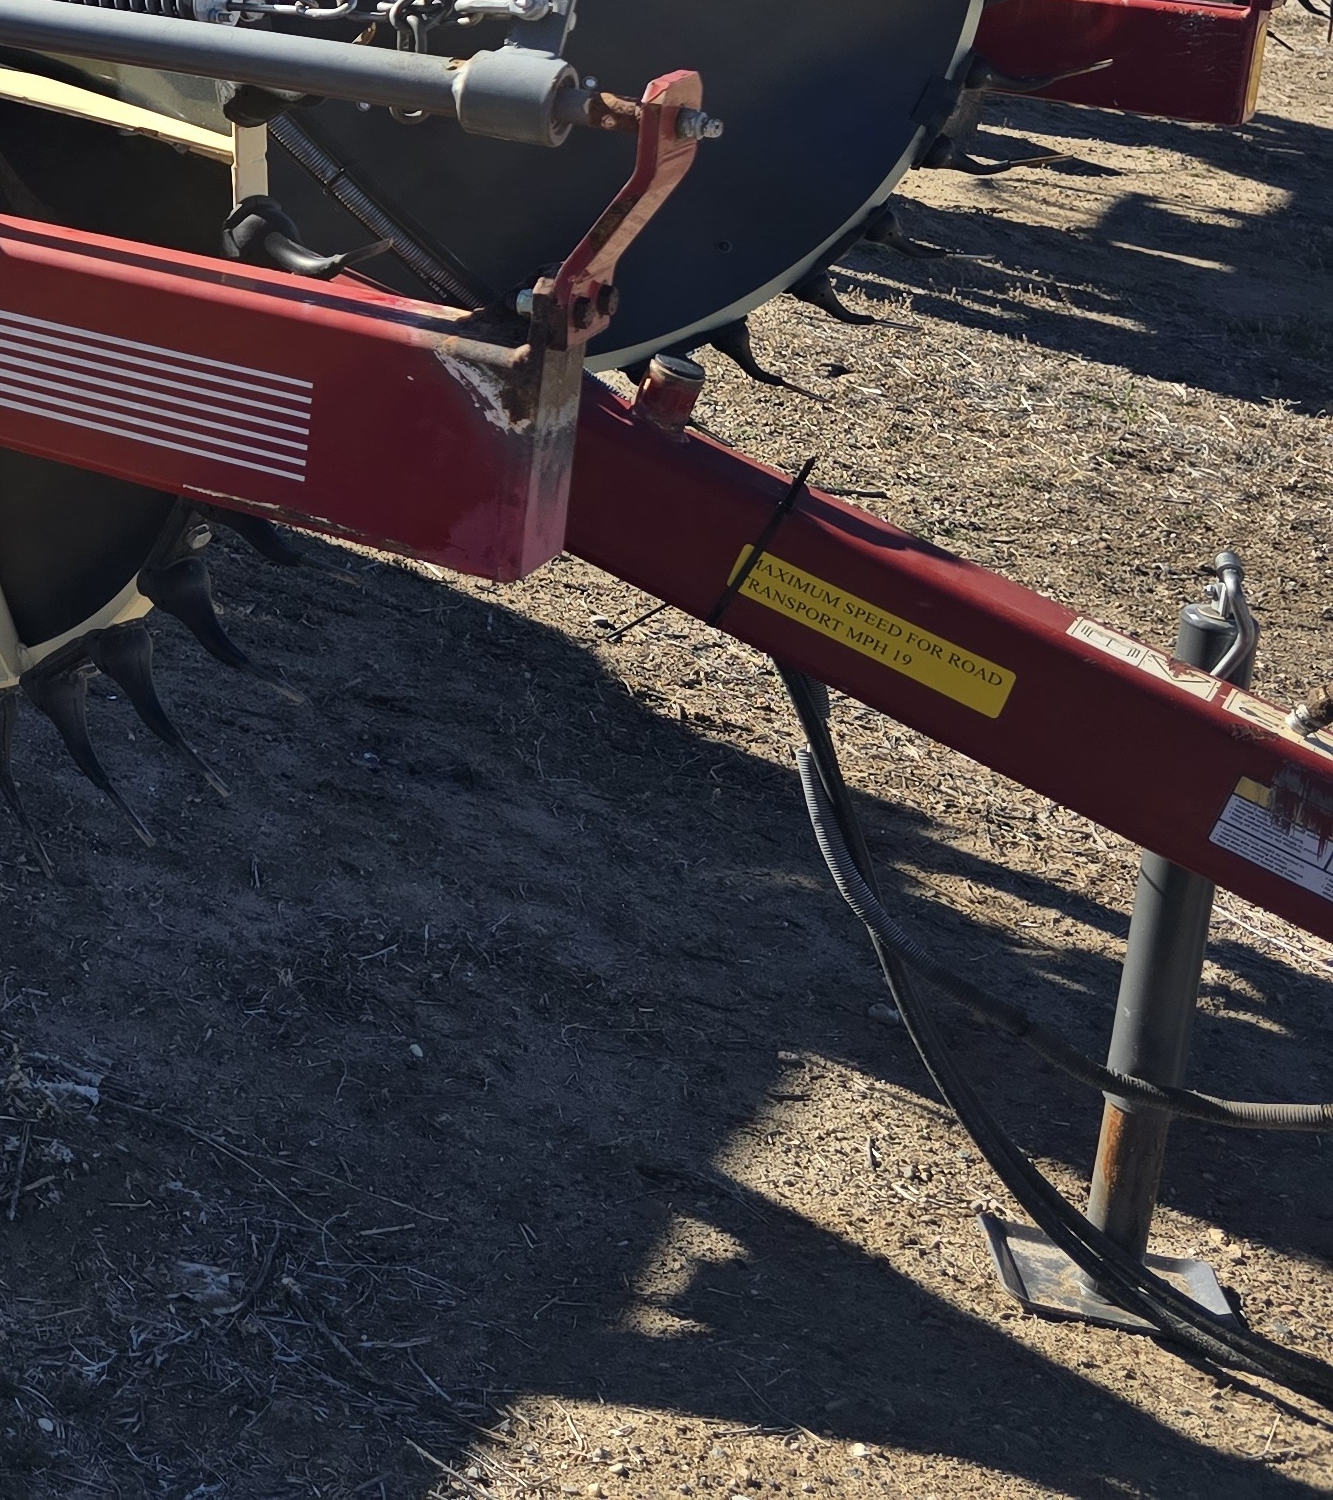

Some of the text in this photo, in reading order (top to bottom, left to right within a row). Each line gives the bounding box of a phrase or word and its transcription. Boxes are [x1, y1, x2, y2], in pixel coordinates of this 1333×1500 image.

[843, 602, 903, 638] SPEED
[908, 632, 943, 660] FOR
[947, 653, 1003, 687] ROAD
[846, 626, 894, 658] MPH
[893, 651, 913, 667] 19
